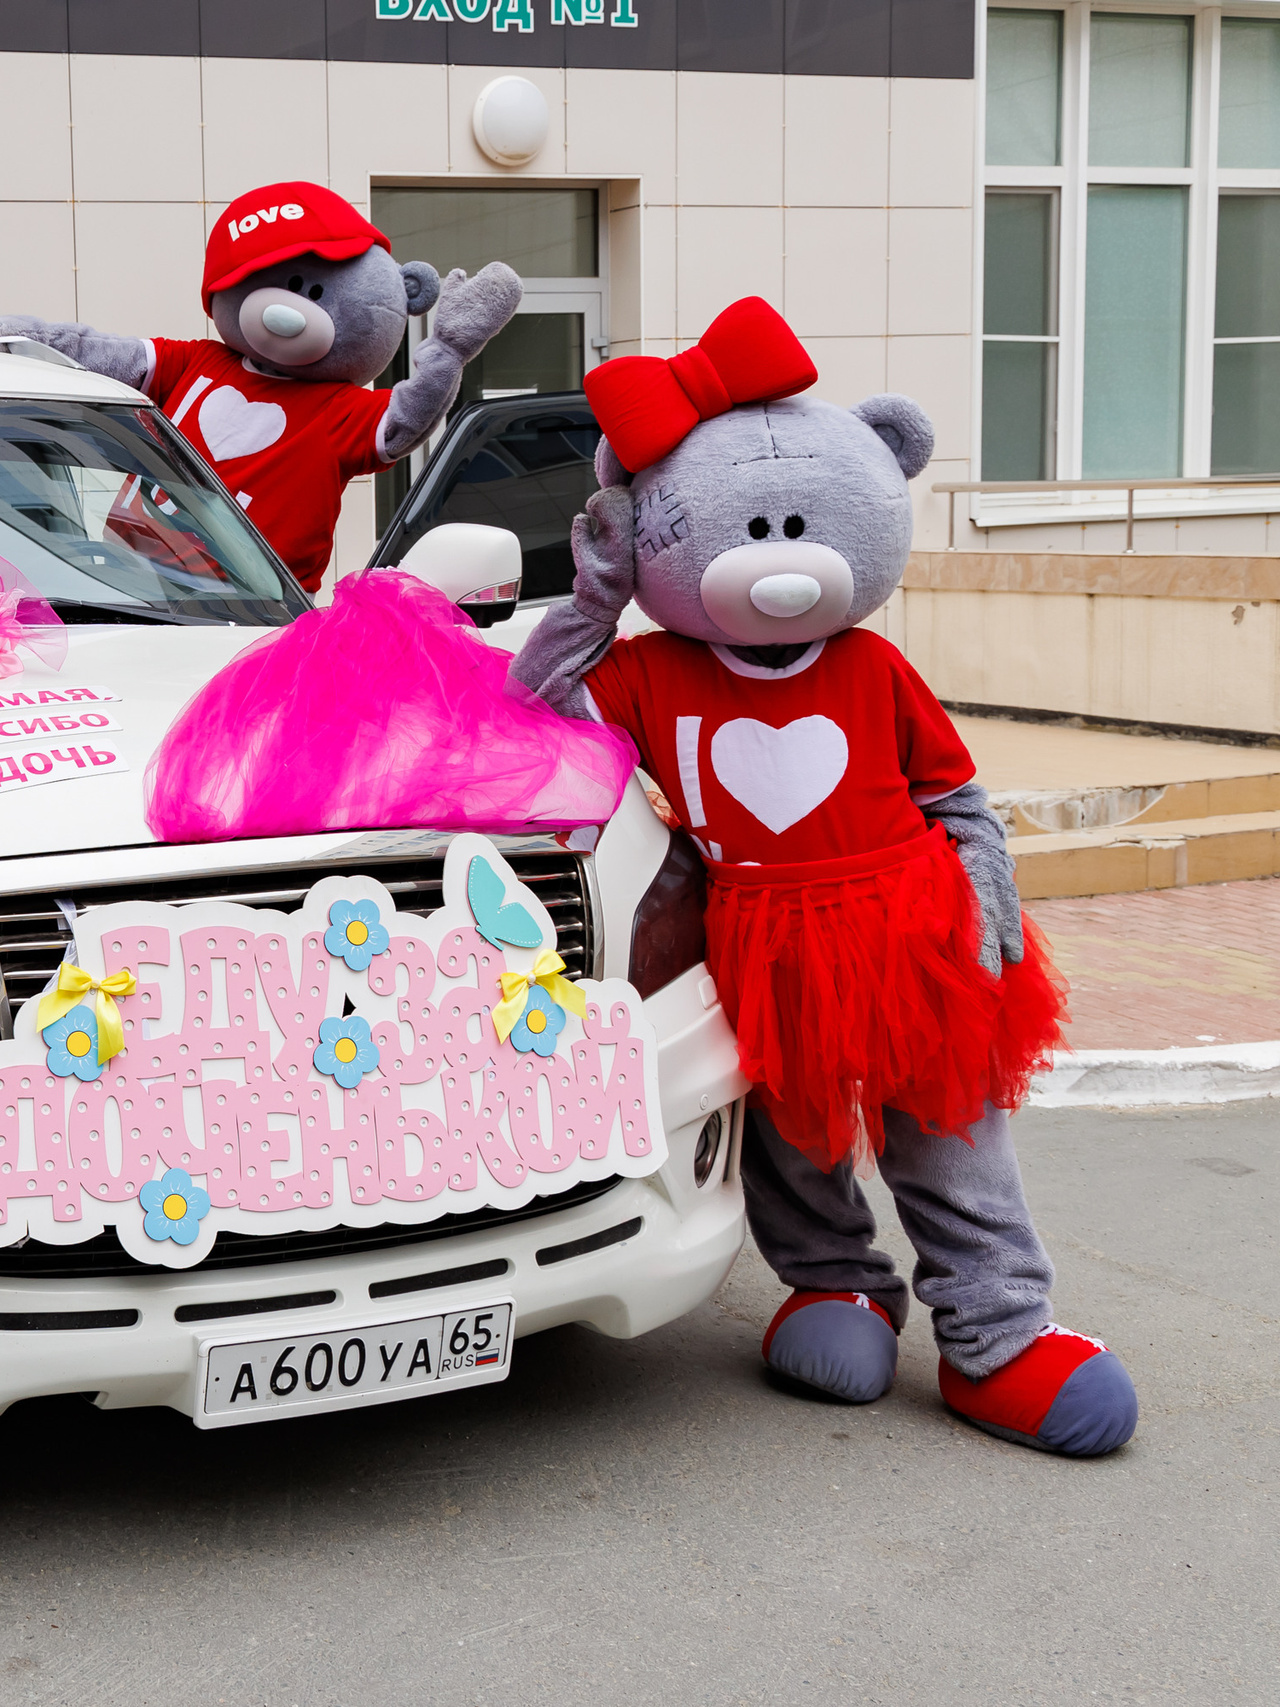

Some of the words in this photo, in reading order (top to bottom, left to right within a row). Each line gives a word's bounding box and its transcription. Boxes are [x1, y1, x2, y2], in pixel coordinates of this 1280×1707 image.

[228, 203, 305, 241] love
[101, 925, 330, 1085] ЕДУ
[449, 1313, 493, 1354] 65
[441, 1354, 474, 1373] RUS
